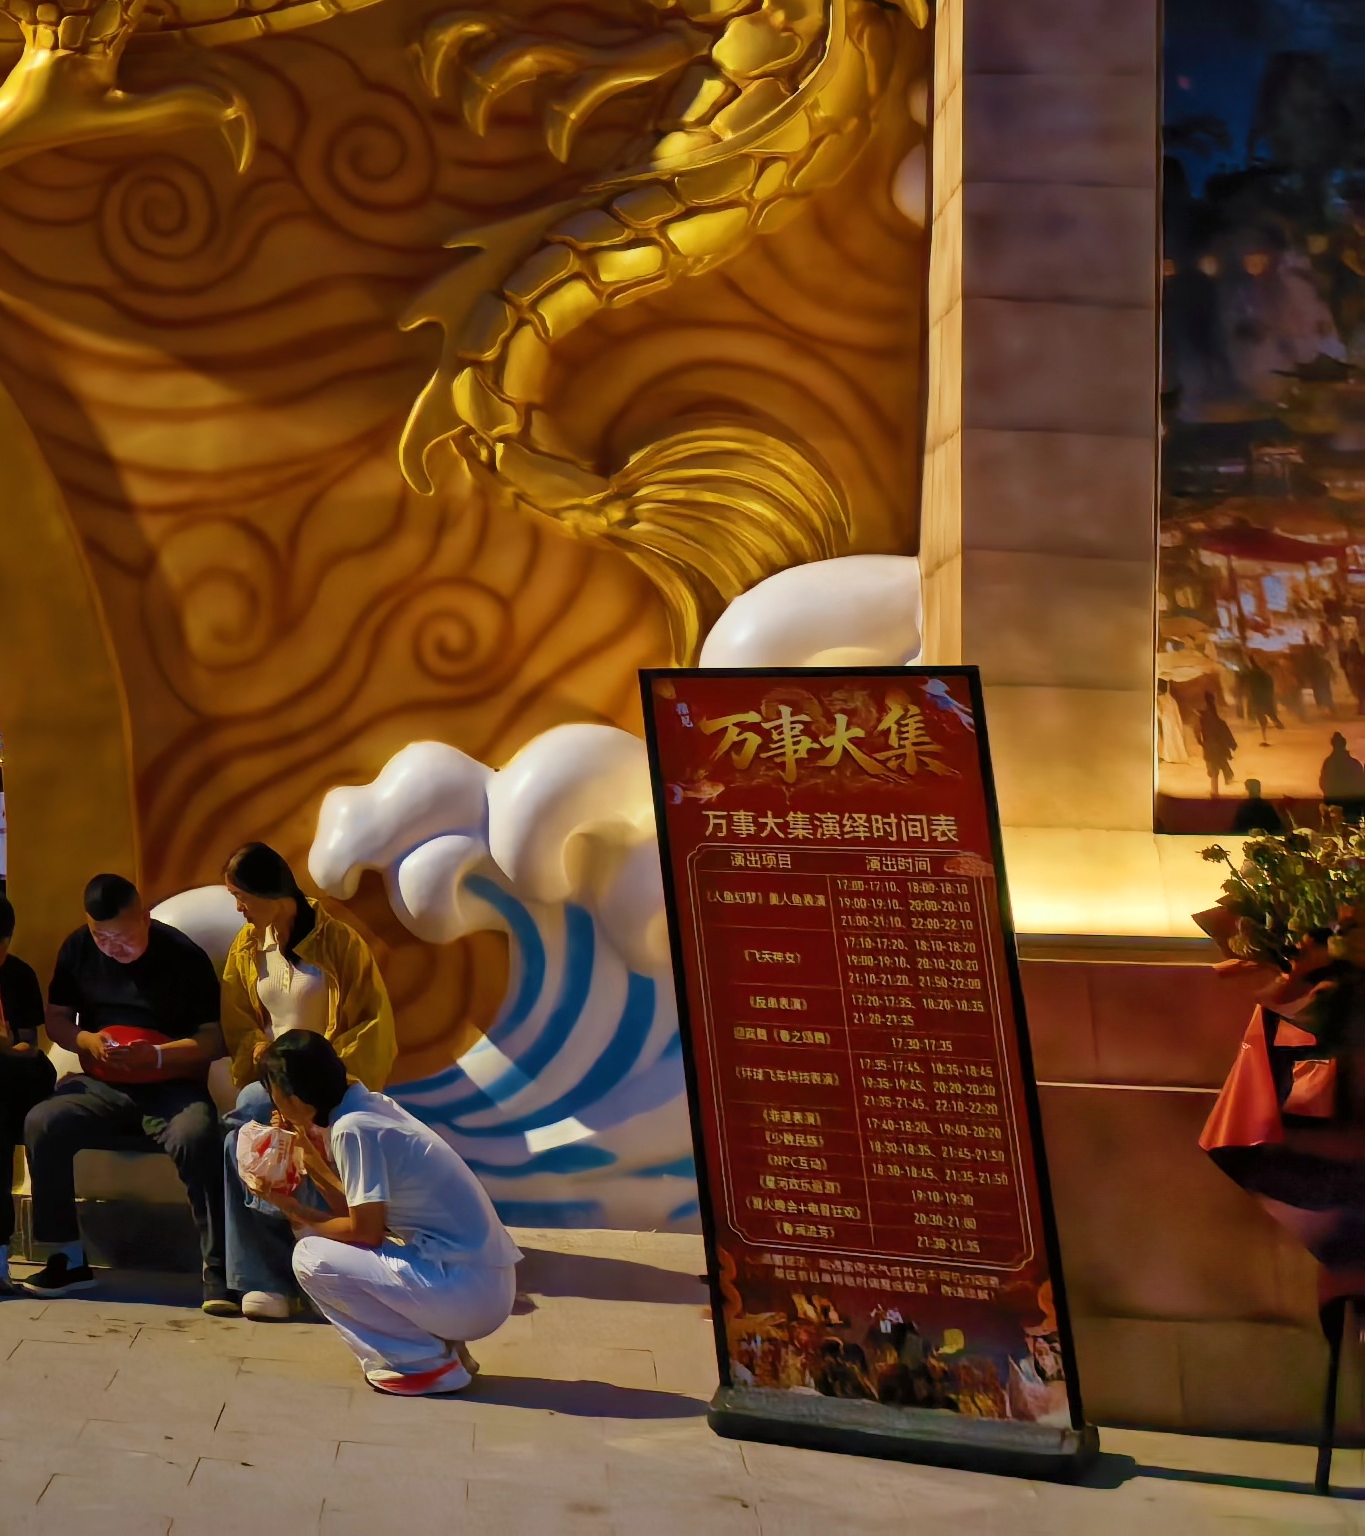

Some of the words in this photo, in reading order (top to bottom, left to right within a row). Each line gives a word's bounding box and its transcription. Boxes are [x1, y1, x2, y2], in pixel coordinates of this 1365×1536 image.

[700, 704, 962, 784] 万事大集
[702, 810, 959, 842] 万事大集演绎时间表
[730, 852, 792, 869] 演出项目
[866, 855, 931, 874] 演出时间
